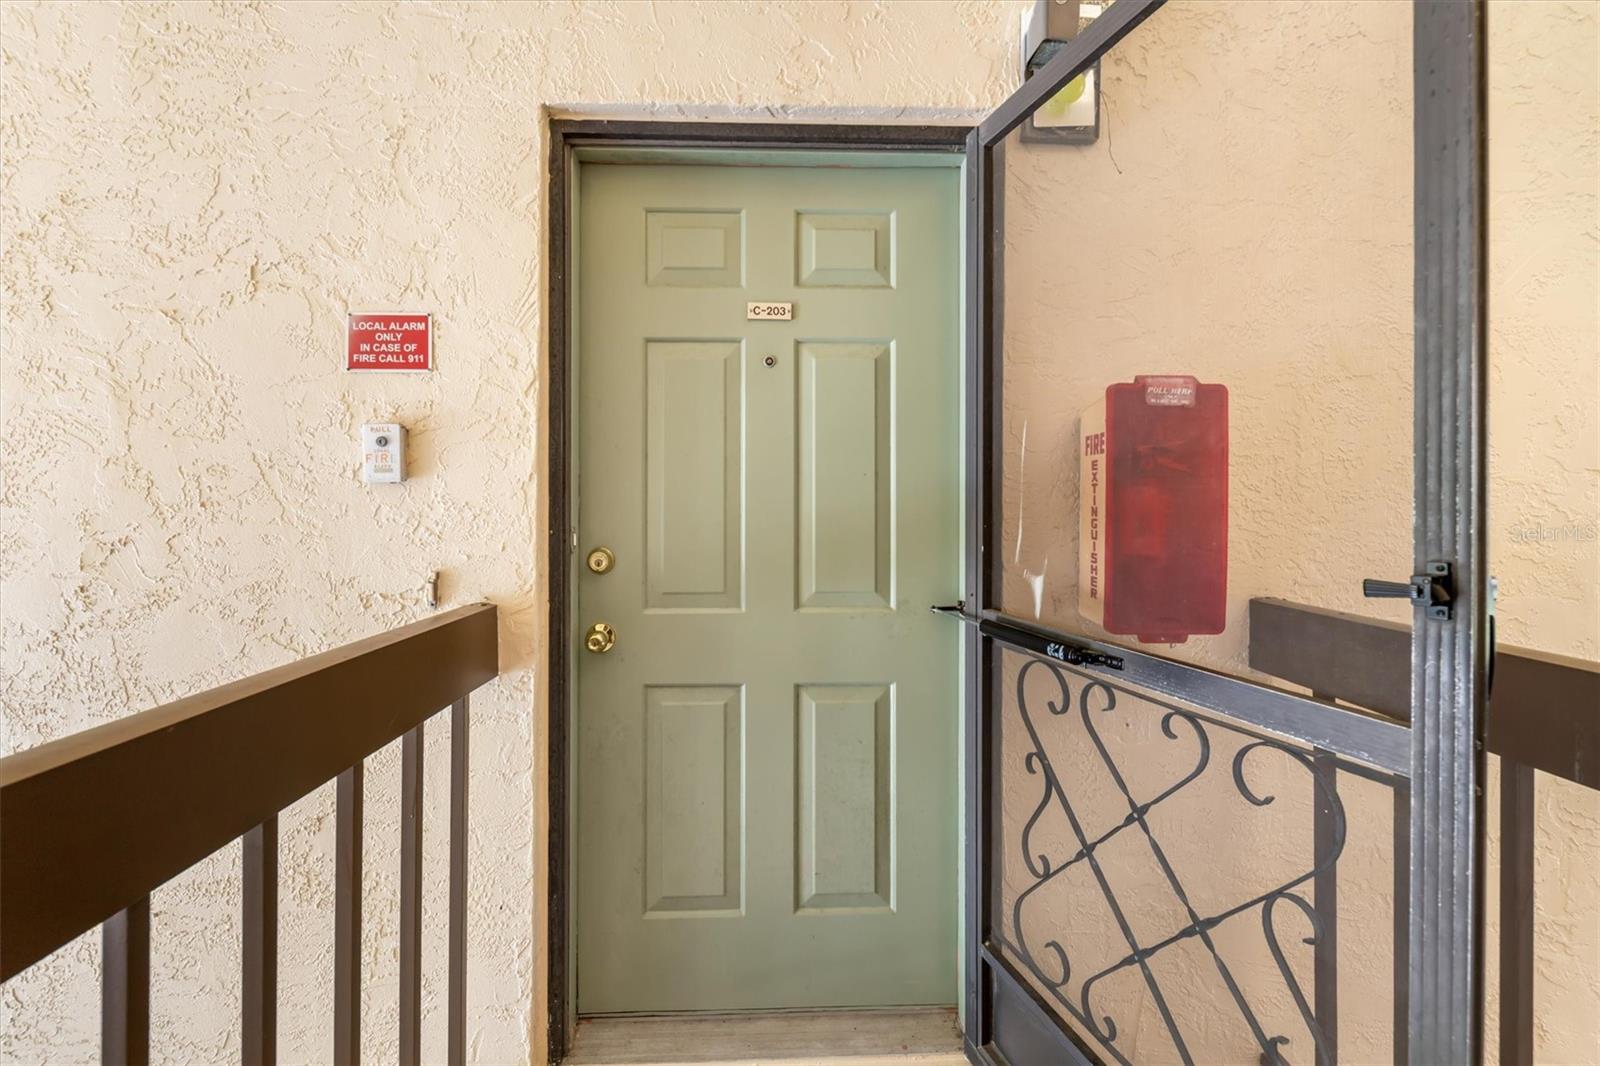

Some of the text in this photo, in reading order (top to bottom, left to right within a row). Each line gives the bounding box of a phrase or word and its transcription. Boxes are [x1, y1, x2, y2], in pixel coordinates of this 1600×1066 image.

[352, 321, 426, 331] LOCAL ALARM
[375, 332, 403, 341] ONLY
[360, 343, 418, 352] IN CASE OF
[353, 354, 424, 363] FIRE CALL 911
[1085, 432, 1105, 456] FIRE
[1090, 459, 1099, 599] EXTINGUISHER
